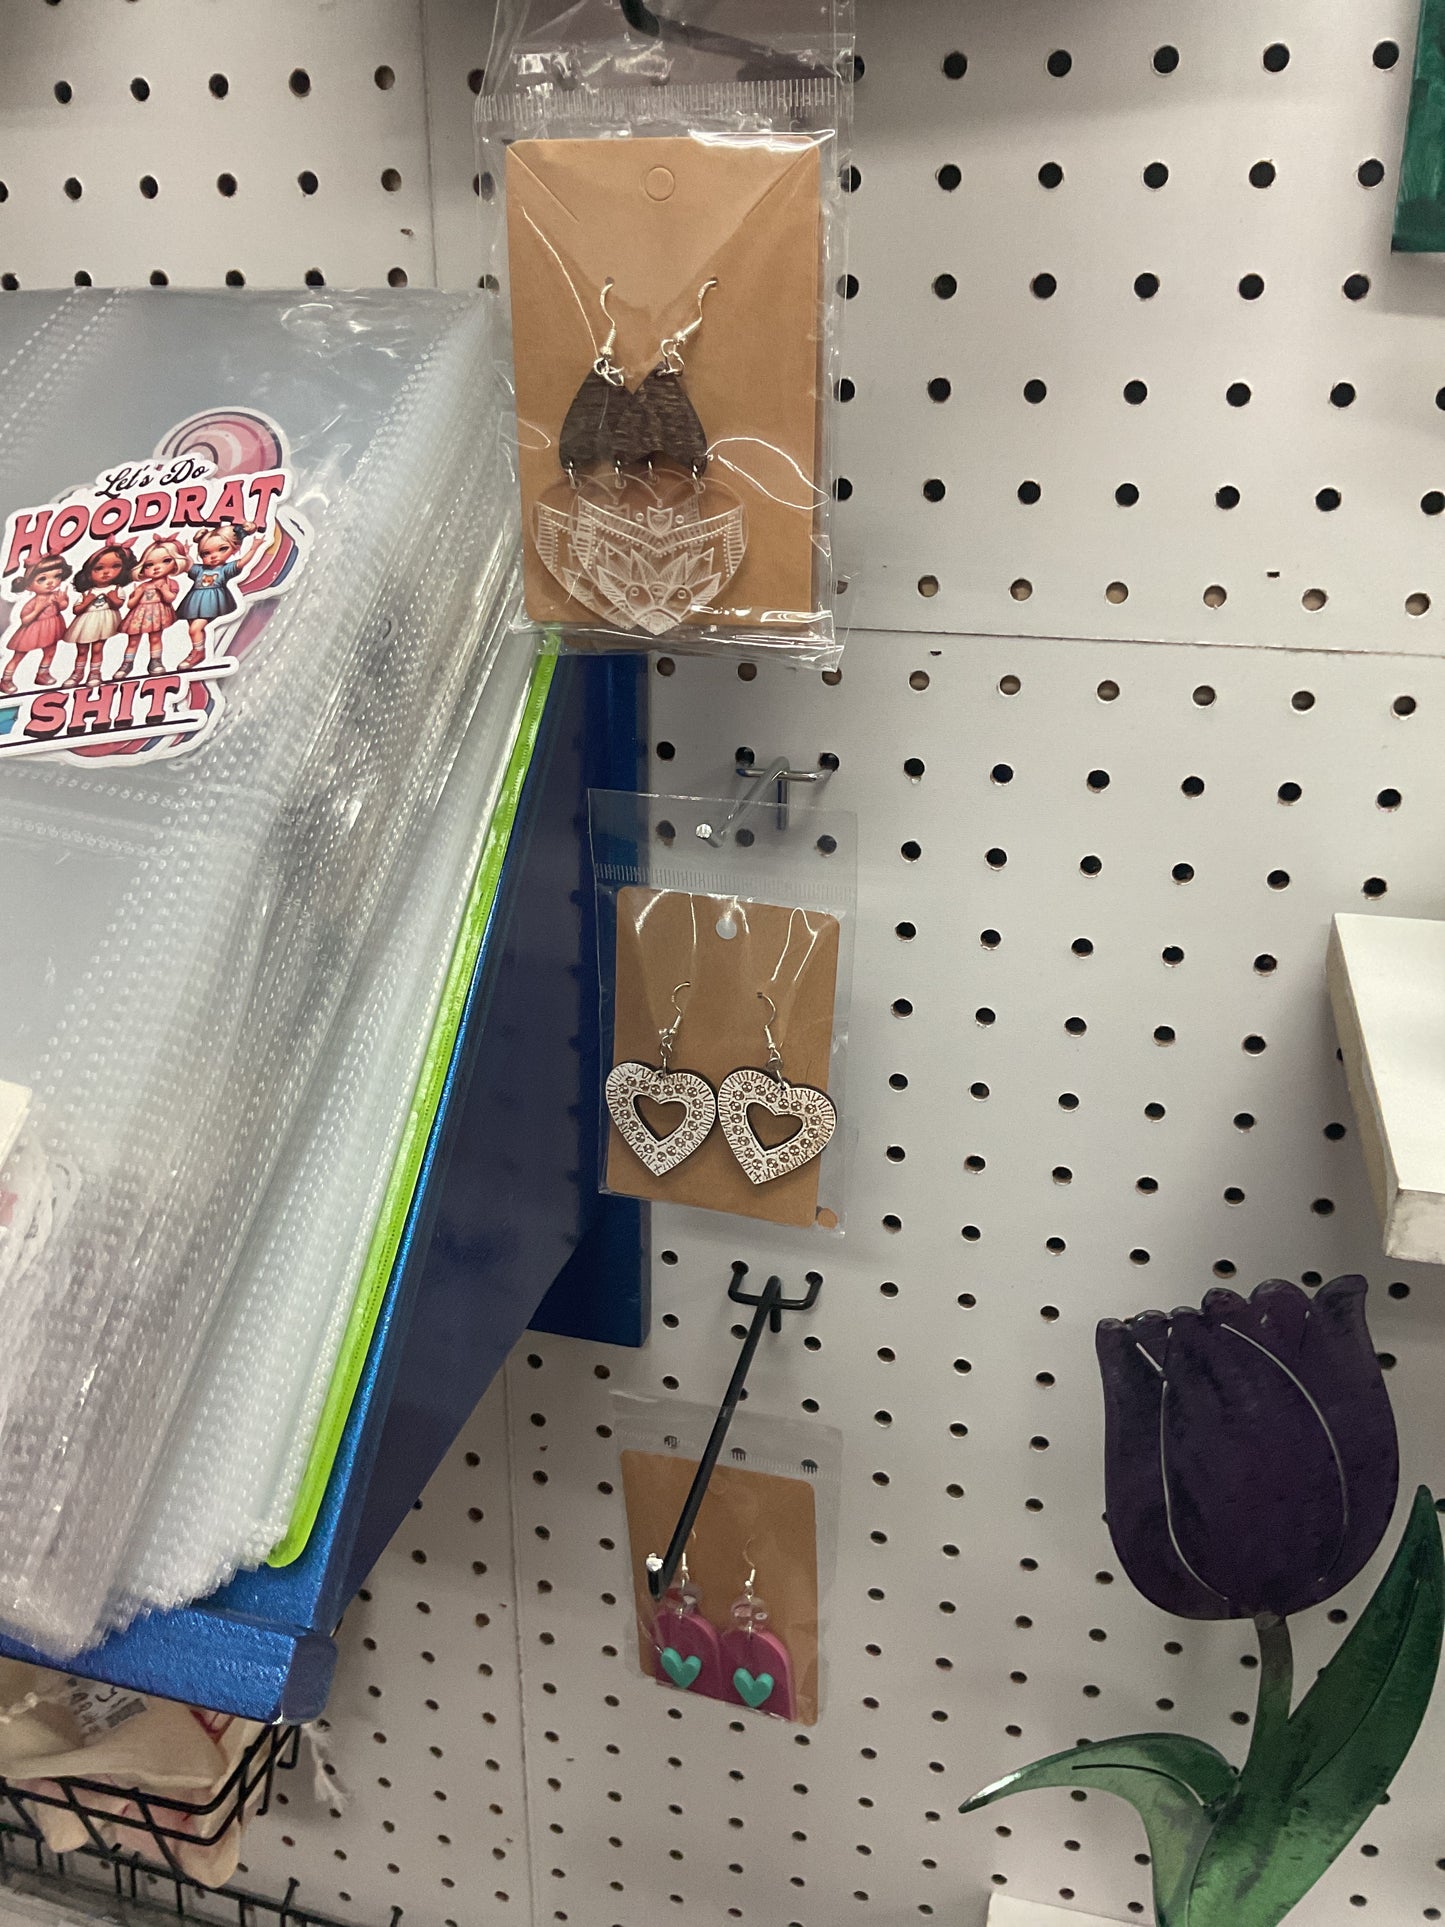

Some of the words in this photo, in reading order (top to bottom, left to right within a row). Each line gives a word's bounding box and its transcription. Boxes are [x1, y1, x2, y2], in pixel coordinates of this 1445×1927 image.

[95, 467, 154, 499] Let's
[160, 458, 209, 486] Do
[3, 474, 286, 577] HOODRAT
[24, 675, 181, 740] SHIT
